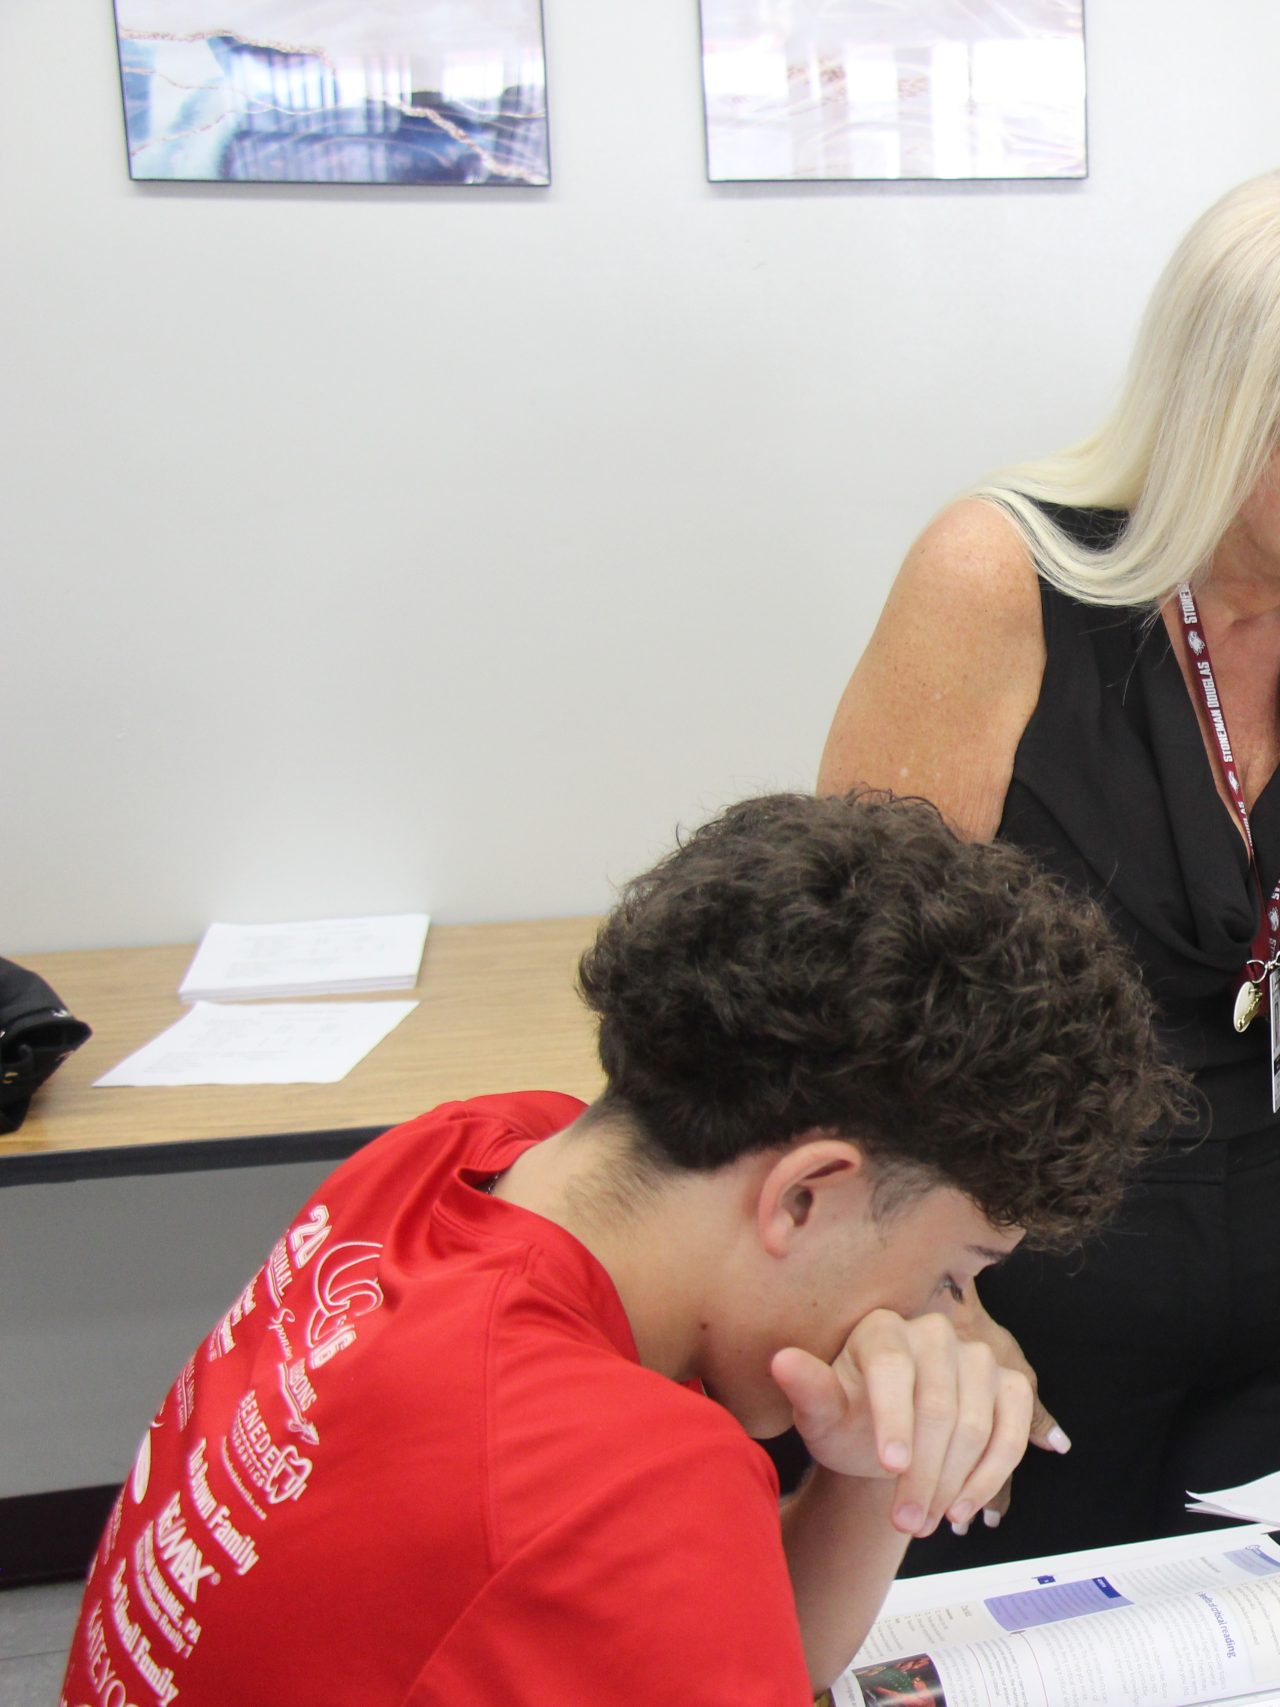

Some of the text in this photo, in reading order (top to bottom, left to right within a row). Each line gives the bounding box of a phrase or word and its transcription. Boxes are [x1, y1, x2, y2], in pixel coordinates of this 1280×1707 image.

[1197, 660, 1233, 763] STONEMAN DOUGLAS
[207, 1505, 260, 1576] Family
[183, 1617, 202, 1644] PA
[1222, 1625, 1237, 1659] reading
[132, 1635, 179, 1707] Family
